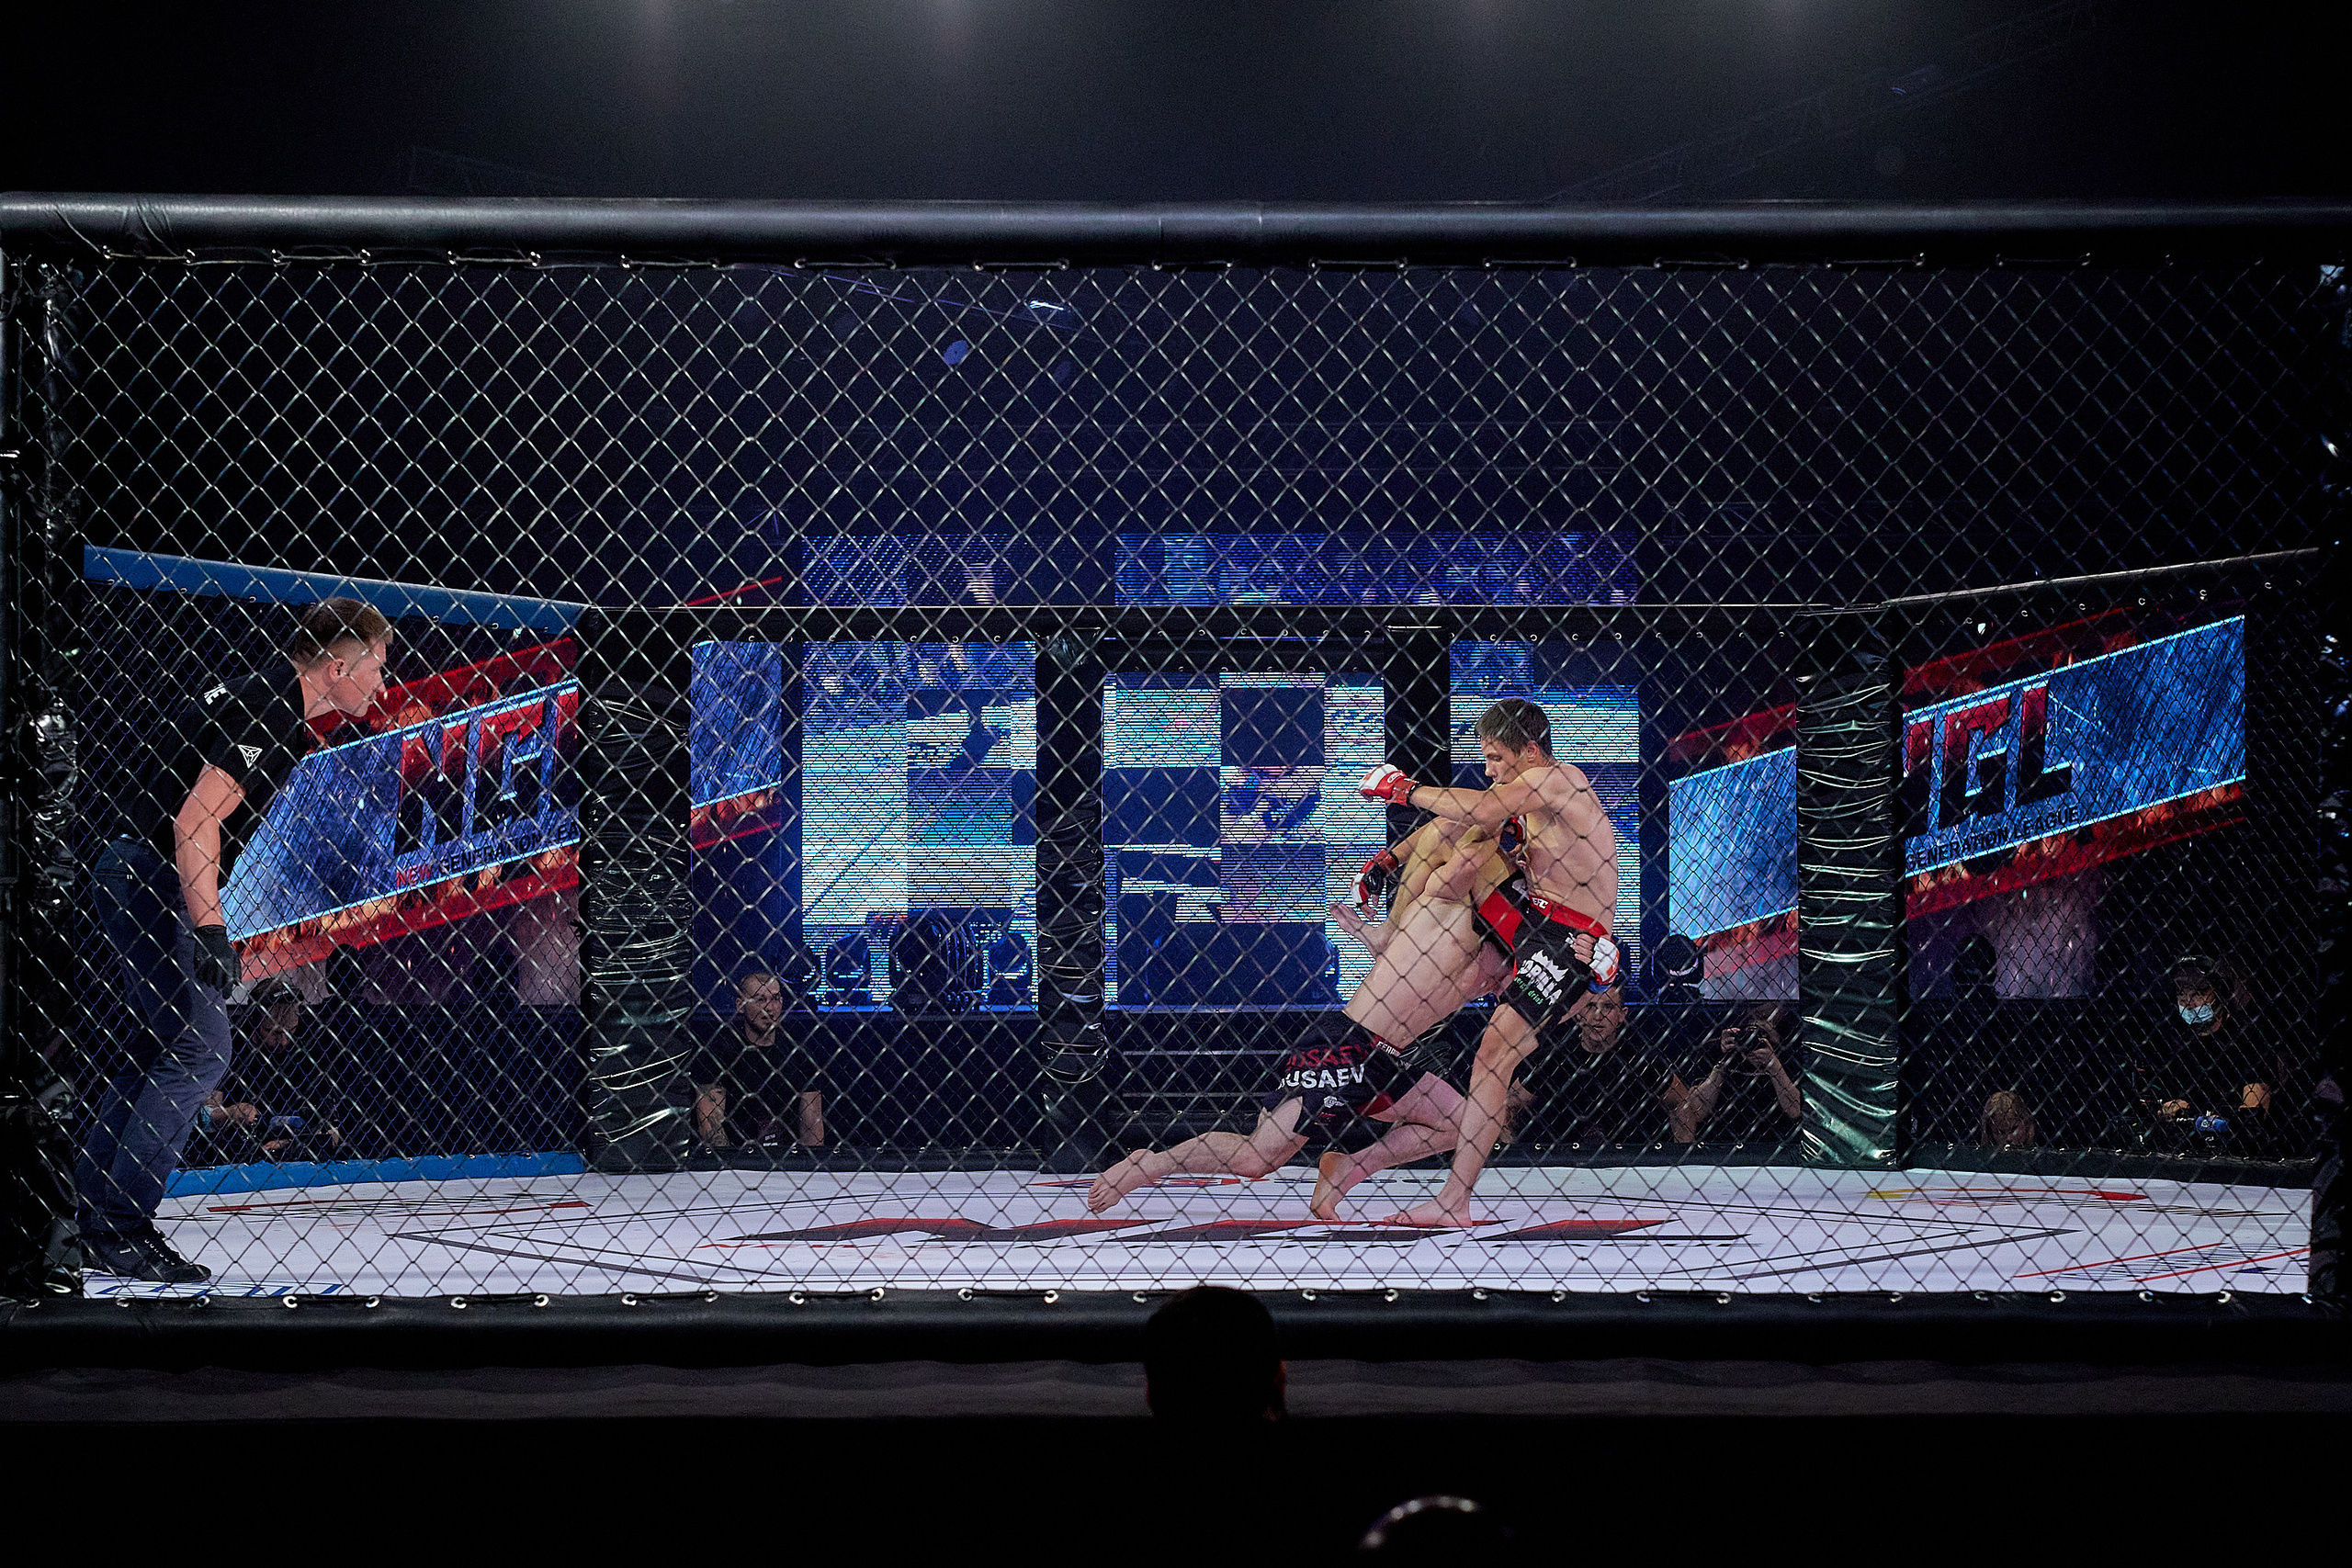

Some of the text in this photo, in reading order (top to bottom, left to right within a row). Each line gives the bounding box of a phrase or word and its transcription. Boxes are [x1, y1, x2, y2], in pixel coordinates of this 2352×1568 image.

[2013, 807, 2080, 839] LEAGUE
[396, 863, 433, 887] NEW
[440, 830, 542, 874] GENERATION
